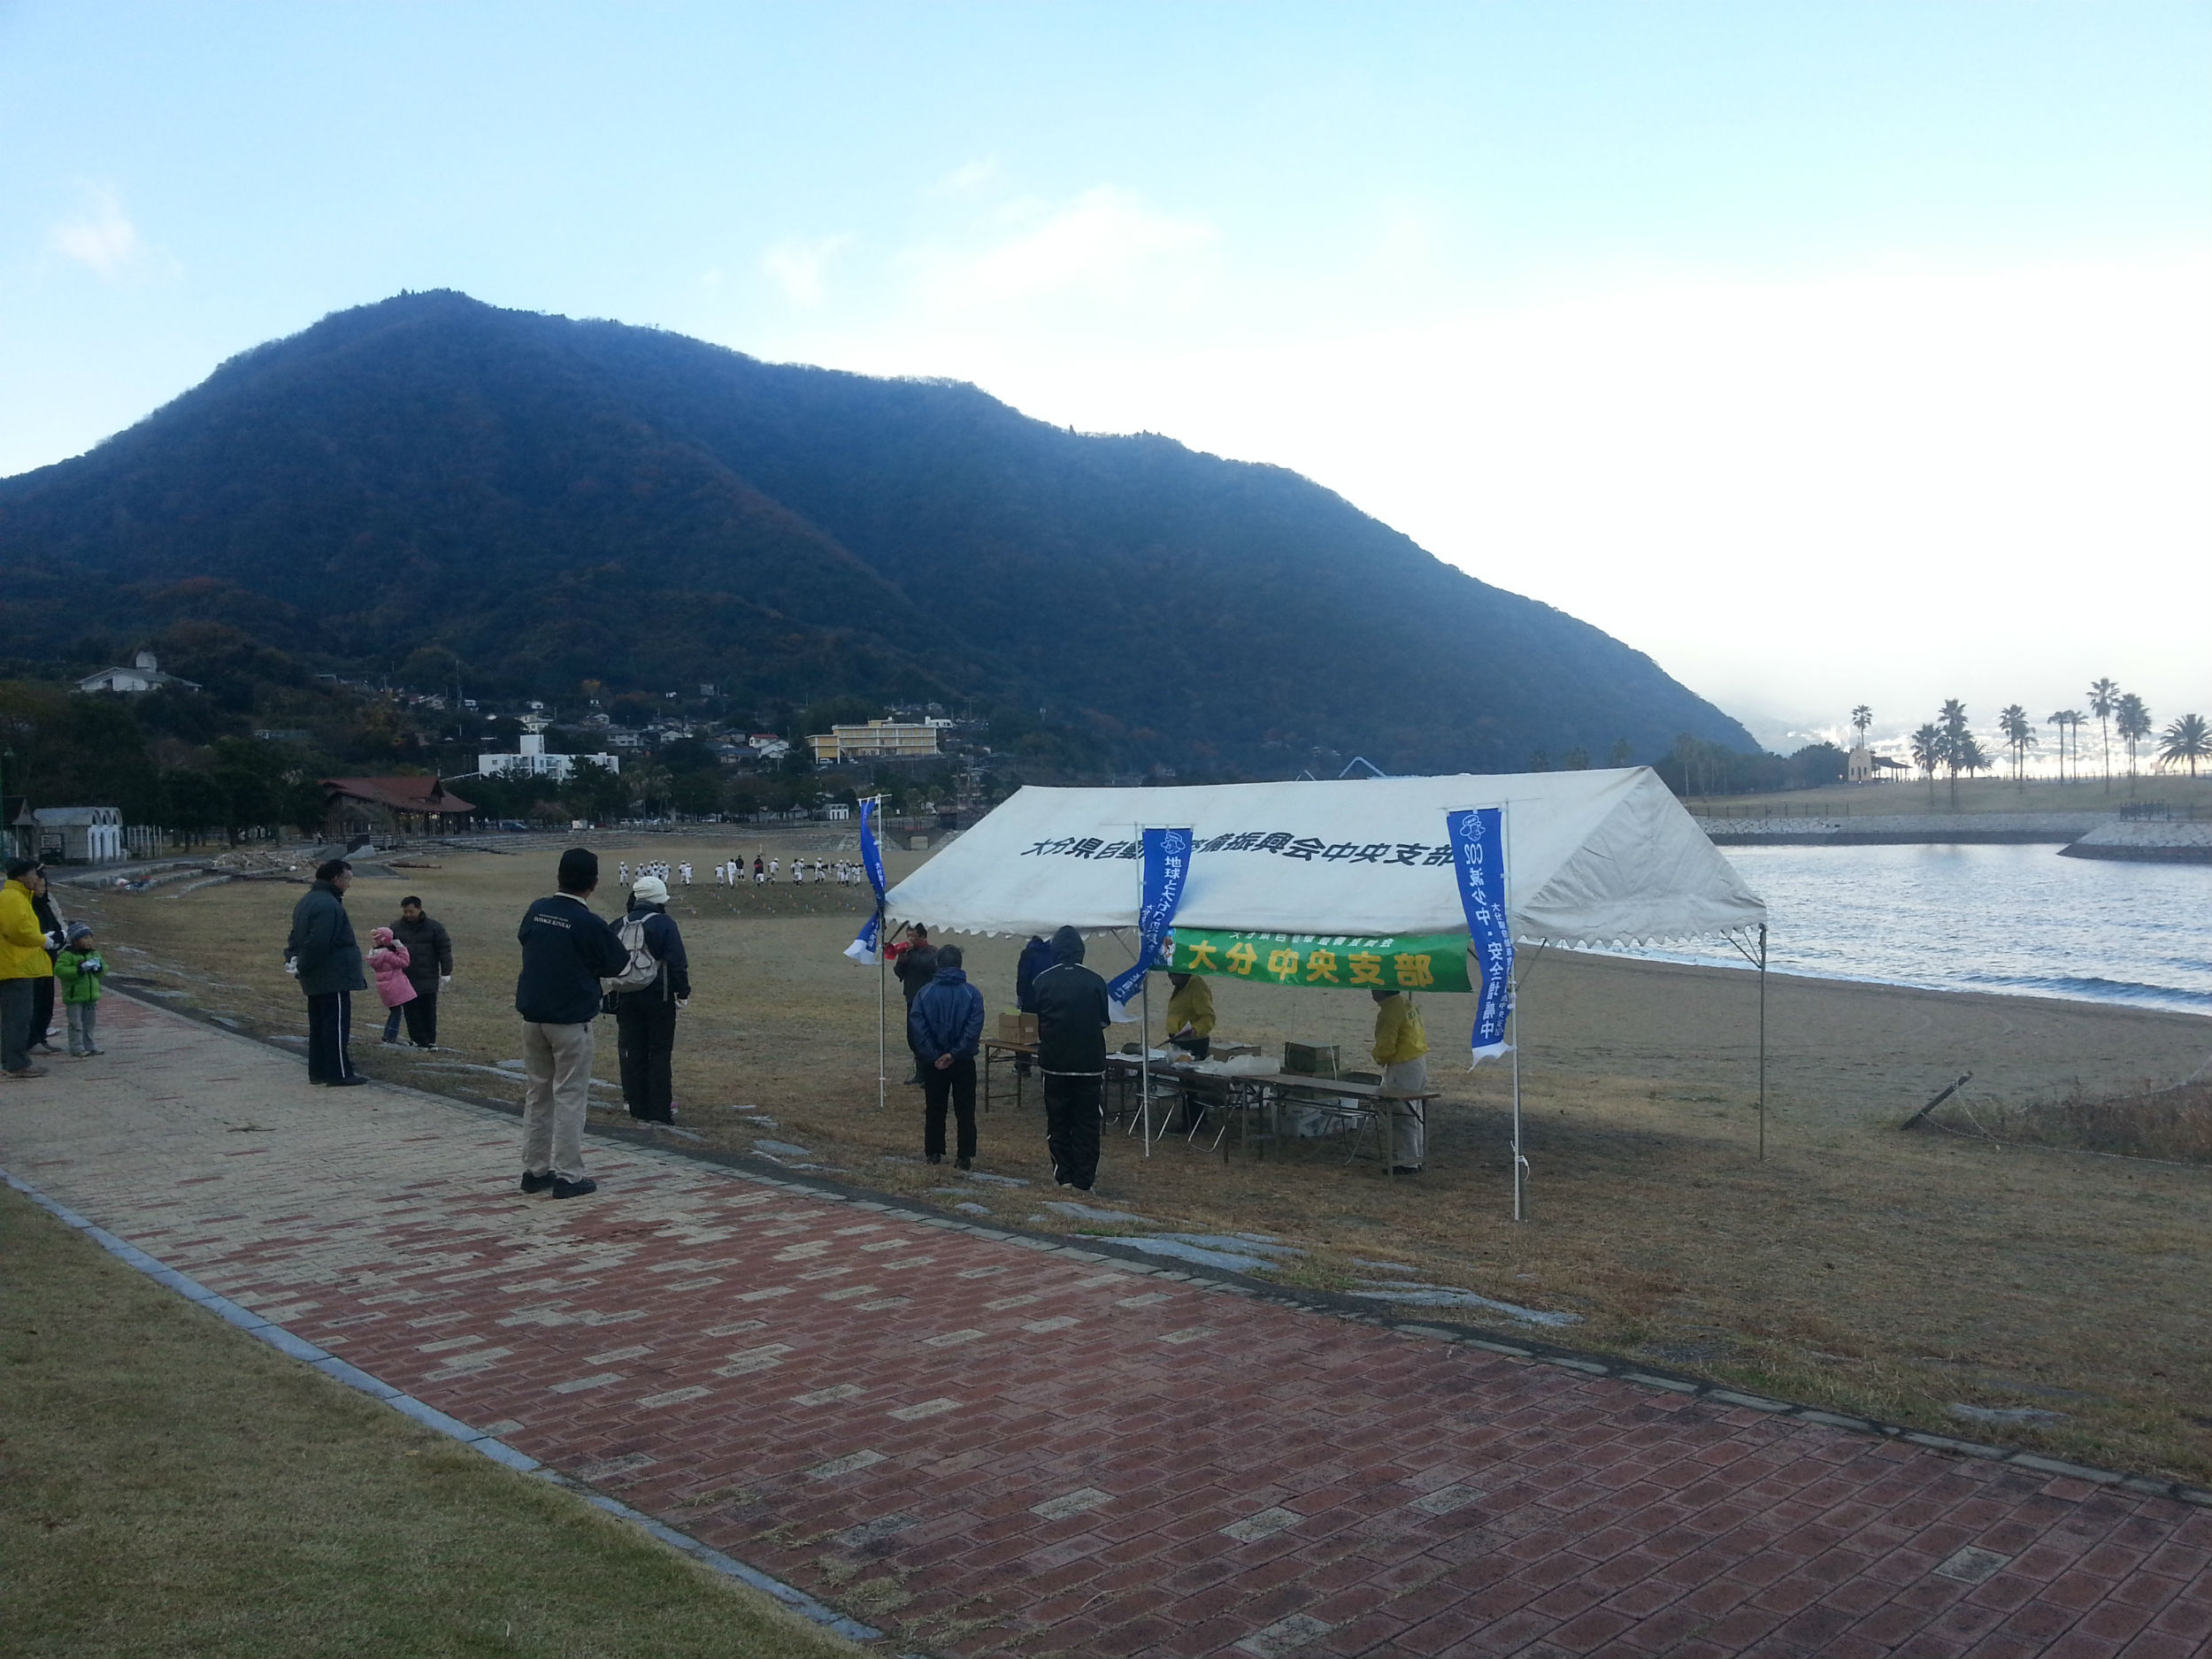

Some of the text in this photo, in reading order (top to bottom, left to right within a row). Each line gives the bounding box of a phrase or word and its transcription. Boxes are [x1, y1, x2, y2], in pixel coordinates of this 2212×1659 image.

[1188, 940, 1435, 987] 大分中央支部
